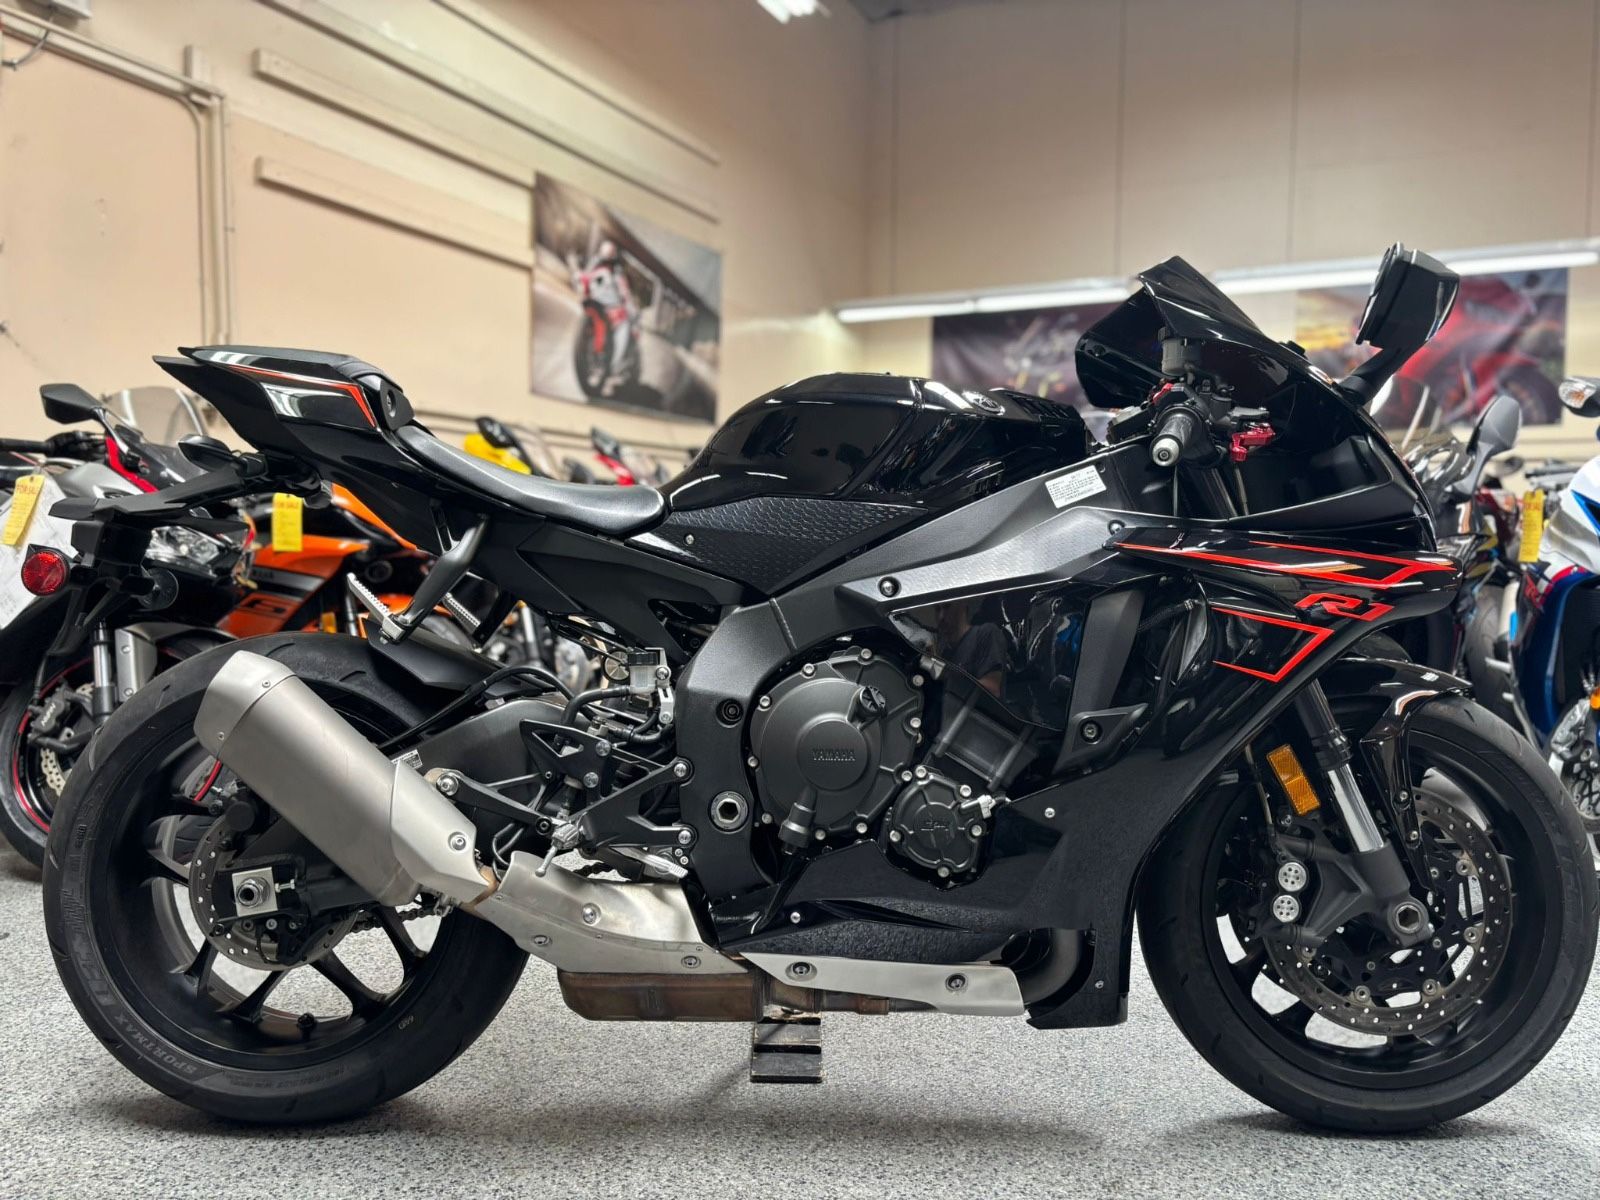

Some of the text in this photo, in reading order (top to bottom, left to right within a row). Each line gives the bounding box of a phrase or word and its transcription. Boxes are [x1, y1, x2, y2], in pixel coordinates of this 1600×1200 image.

[1295, 593, 1394, 622] R1
[812, 748, 856, 761] YAMAHA
[114, 1013, 198, 1074] SPORTMAX
